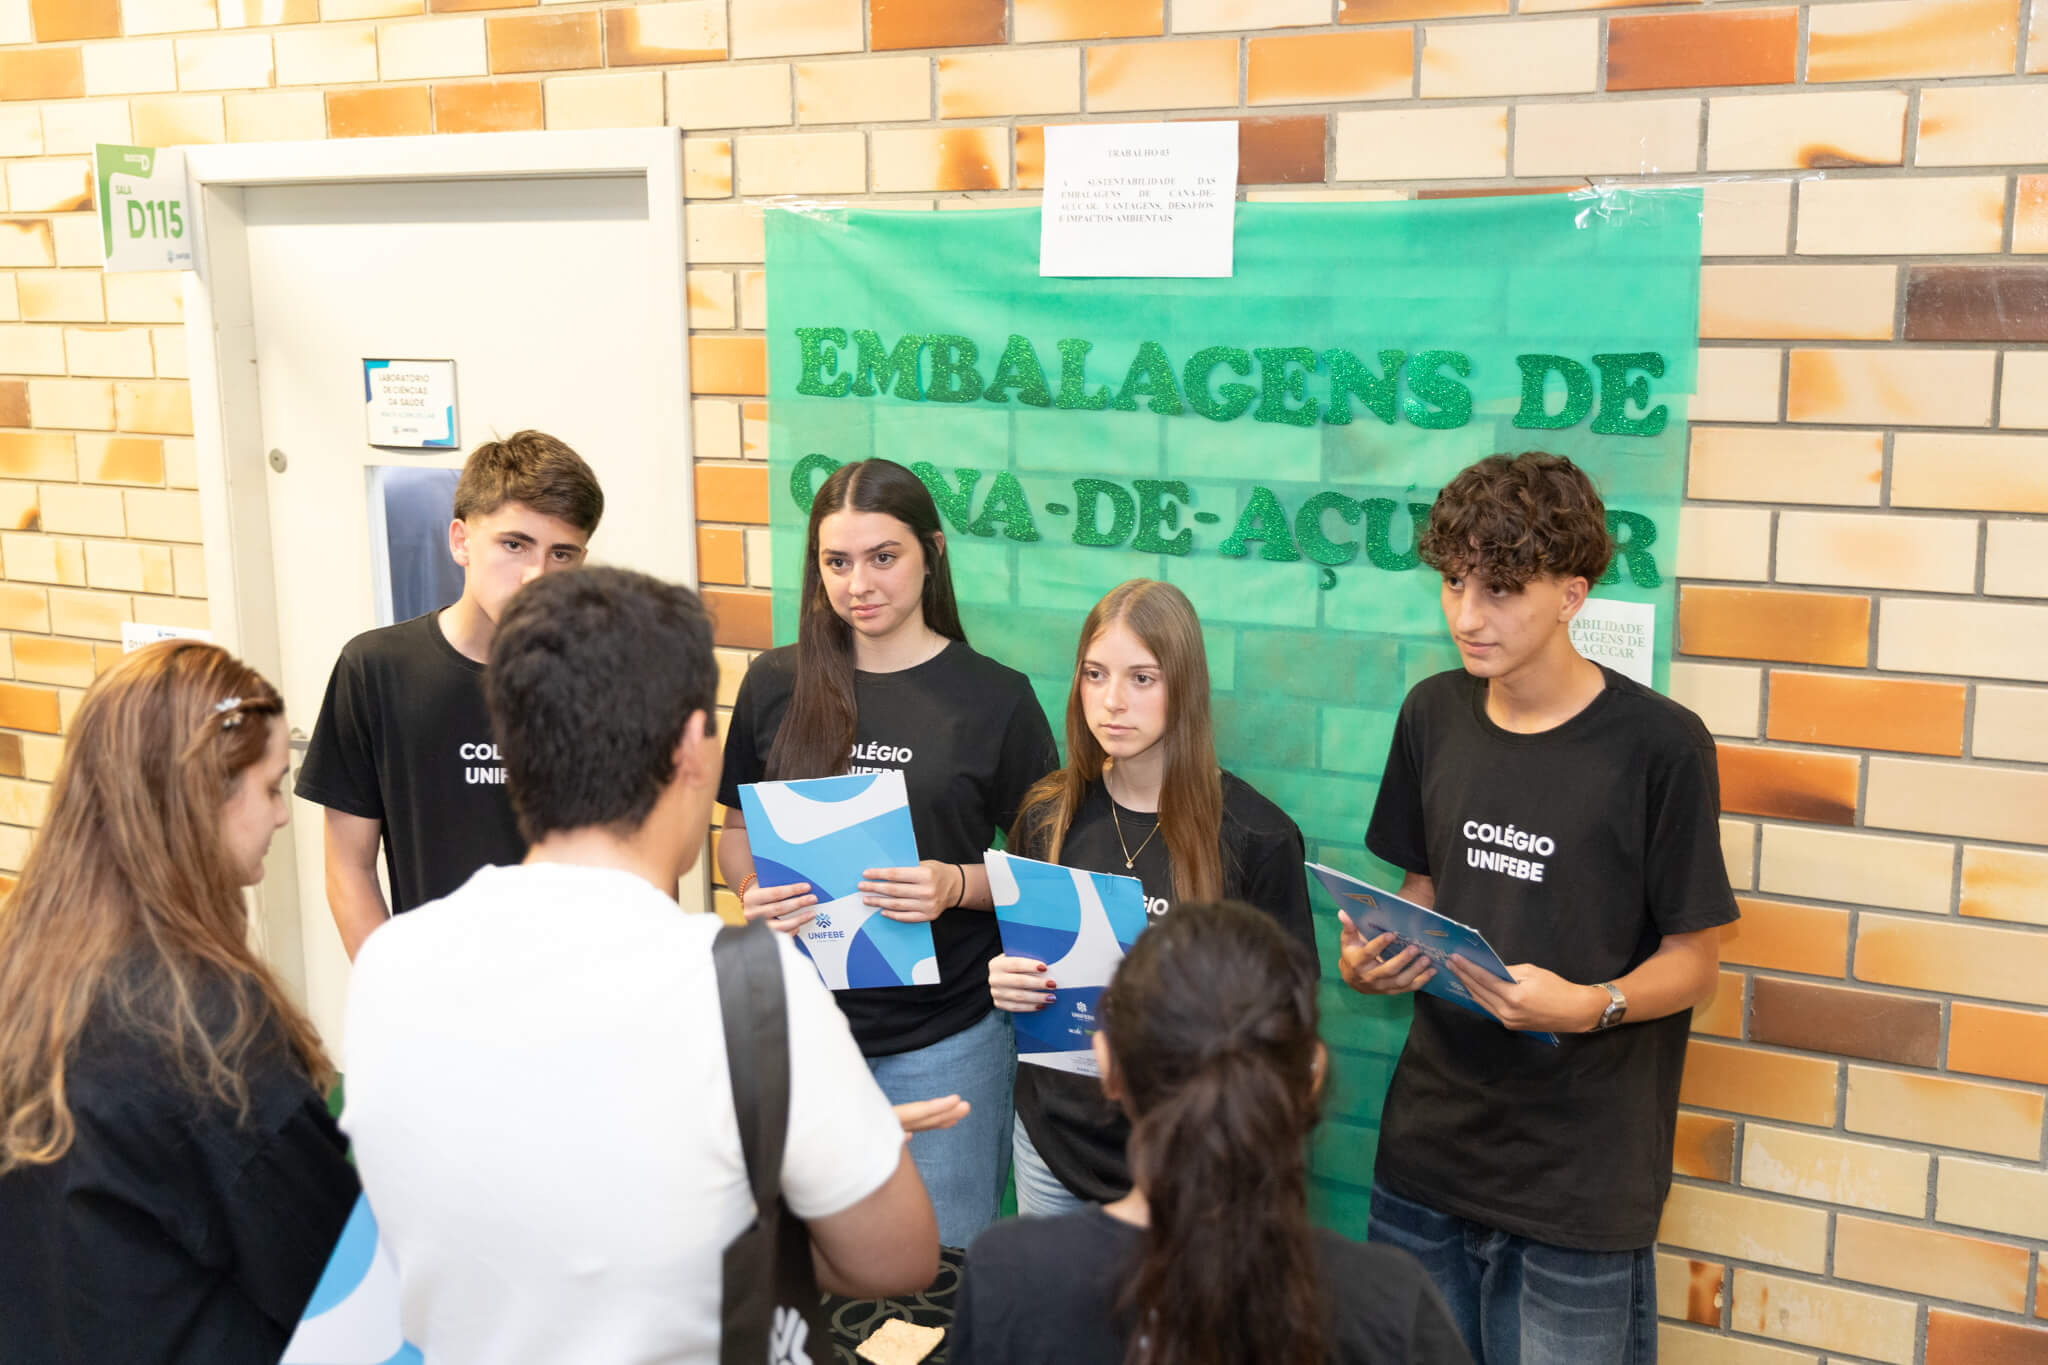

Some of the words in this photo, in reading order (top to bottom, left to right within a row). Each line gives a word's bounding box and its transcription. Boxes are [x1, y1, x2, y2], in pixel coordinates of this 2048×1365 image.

[1197, 176, 1217, 186] DAS
[114, 184, 133, 195] SALA
[1060, 190, 1121, 200] EMBALAGENS
[1138, 189, 1151, 199] DE
[1167, 200, 1215, 211] DESAFIOS
[126, 199, 184, 239] D115
[1066, 213, 1114, 223] IMPACTOS
[1115, 213, 1175, 224] AMBIENTAIS
[796, 326, 1473, 430] EMBALAGENS
[1512, 351, 1669, 437] DE
[1627, 635, 1647, 649] DE
[848, 740, 913, 763] LÉGIO
[465, 767, 509, 785] UNIF
[1463, 820, 1555, 857] COLÉGIO
[1466, 847, 1545, 882] UNIFEBE
[807, 929, 846, 941] UNIFEBE
